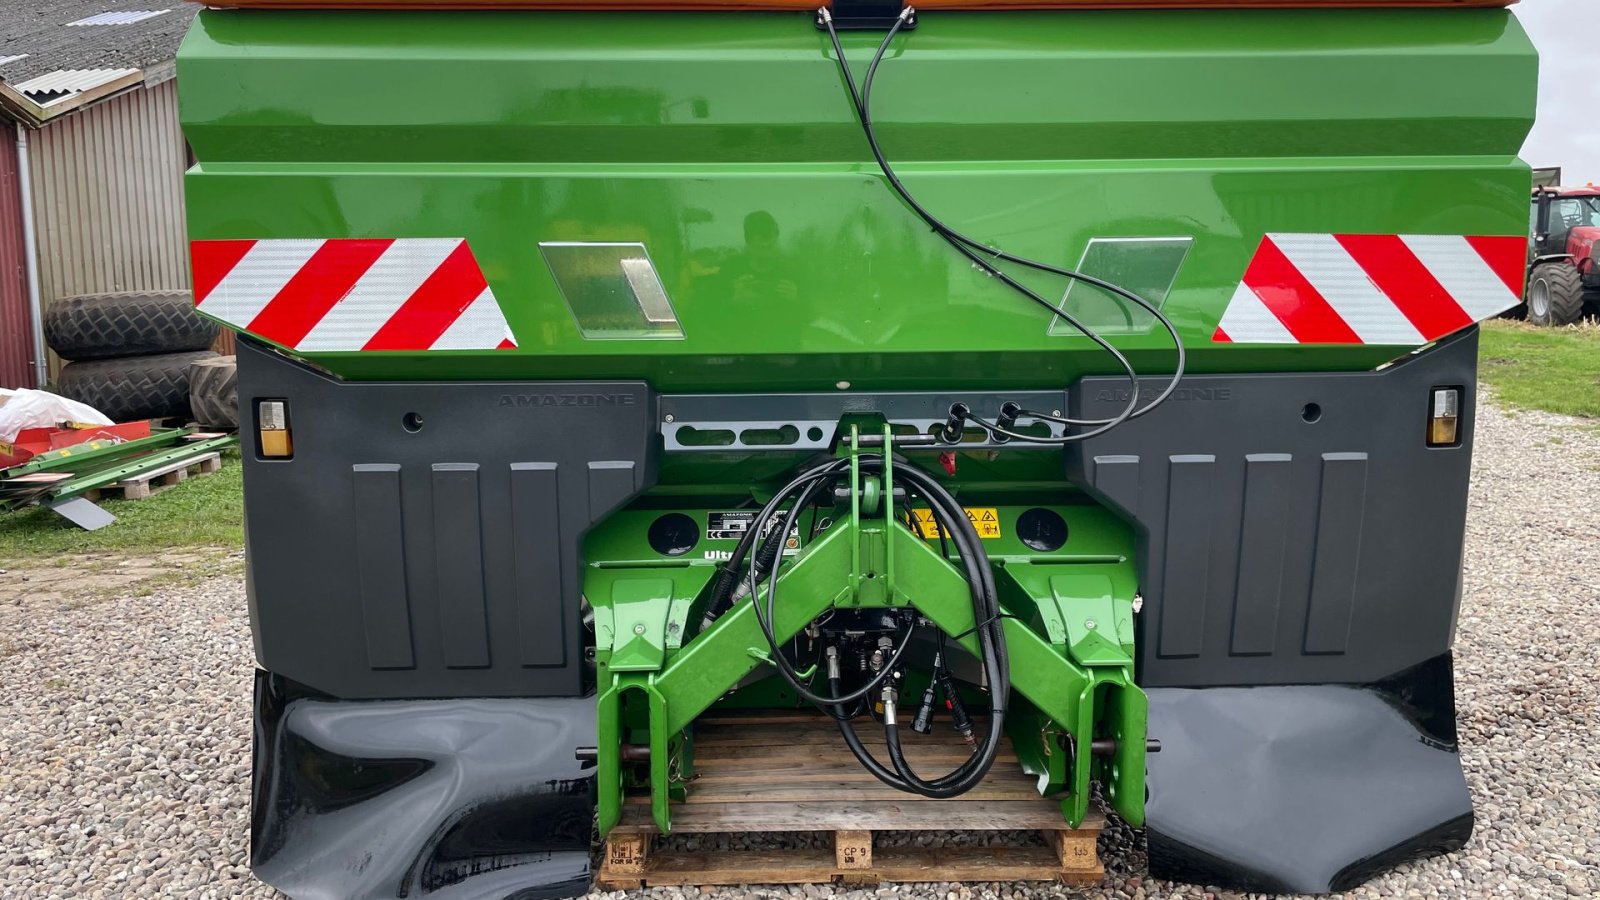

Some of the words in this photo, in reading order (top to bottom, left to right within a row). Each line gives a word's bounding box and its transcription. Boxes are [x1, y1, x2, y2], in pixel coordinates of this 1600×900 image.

[499, 393, 634, 407] AMAZONE
[1096, 387, 1231, 401] AMAONE
[844, 847, 857, 856] CP
[860, 847, 866, 857] 9
